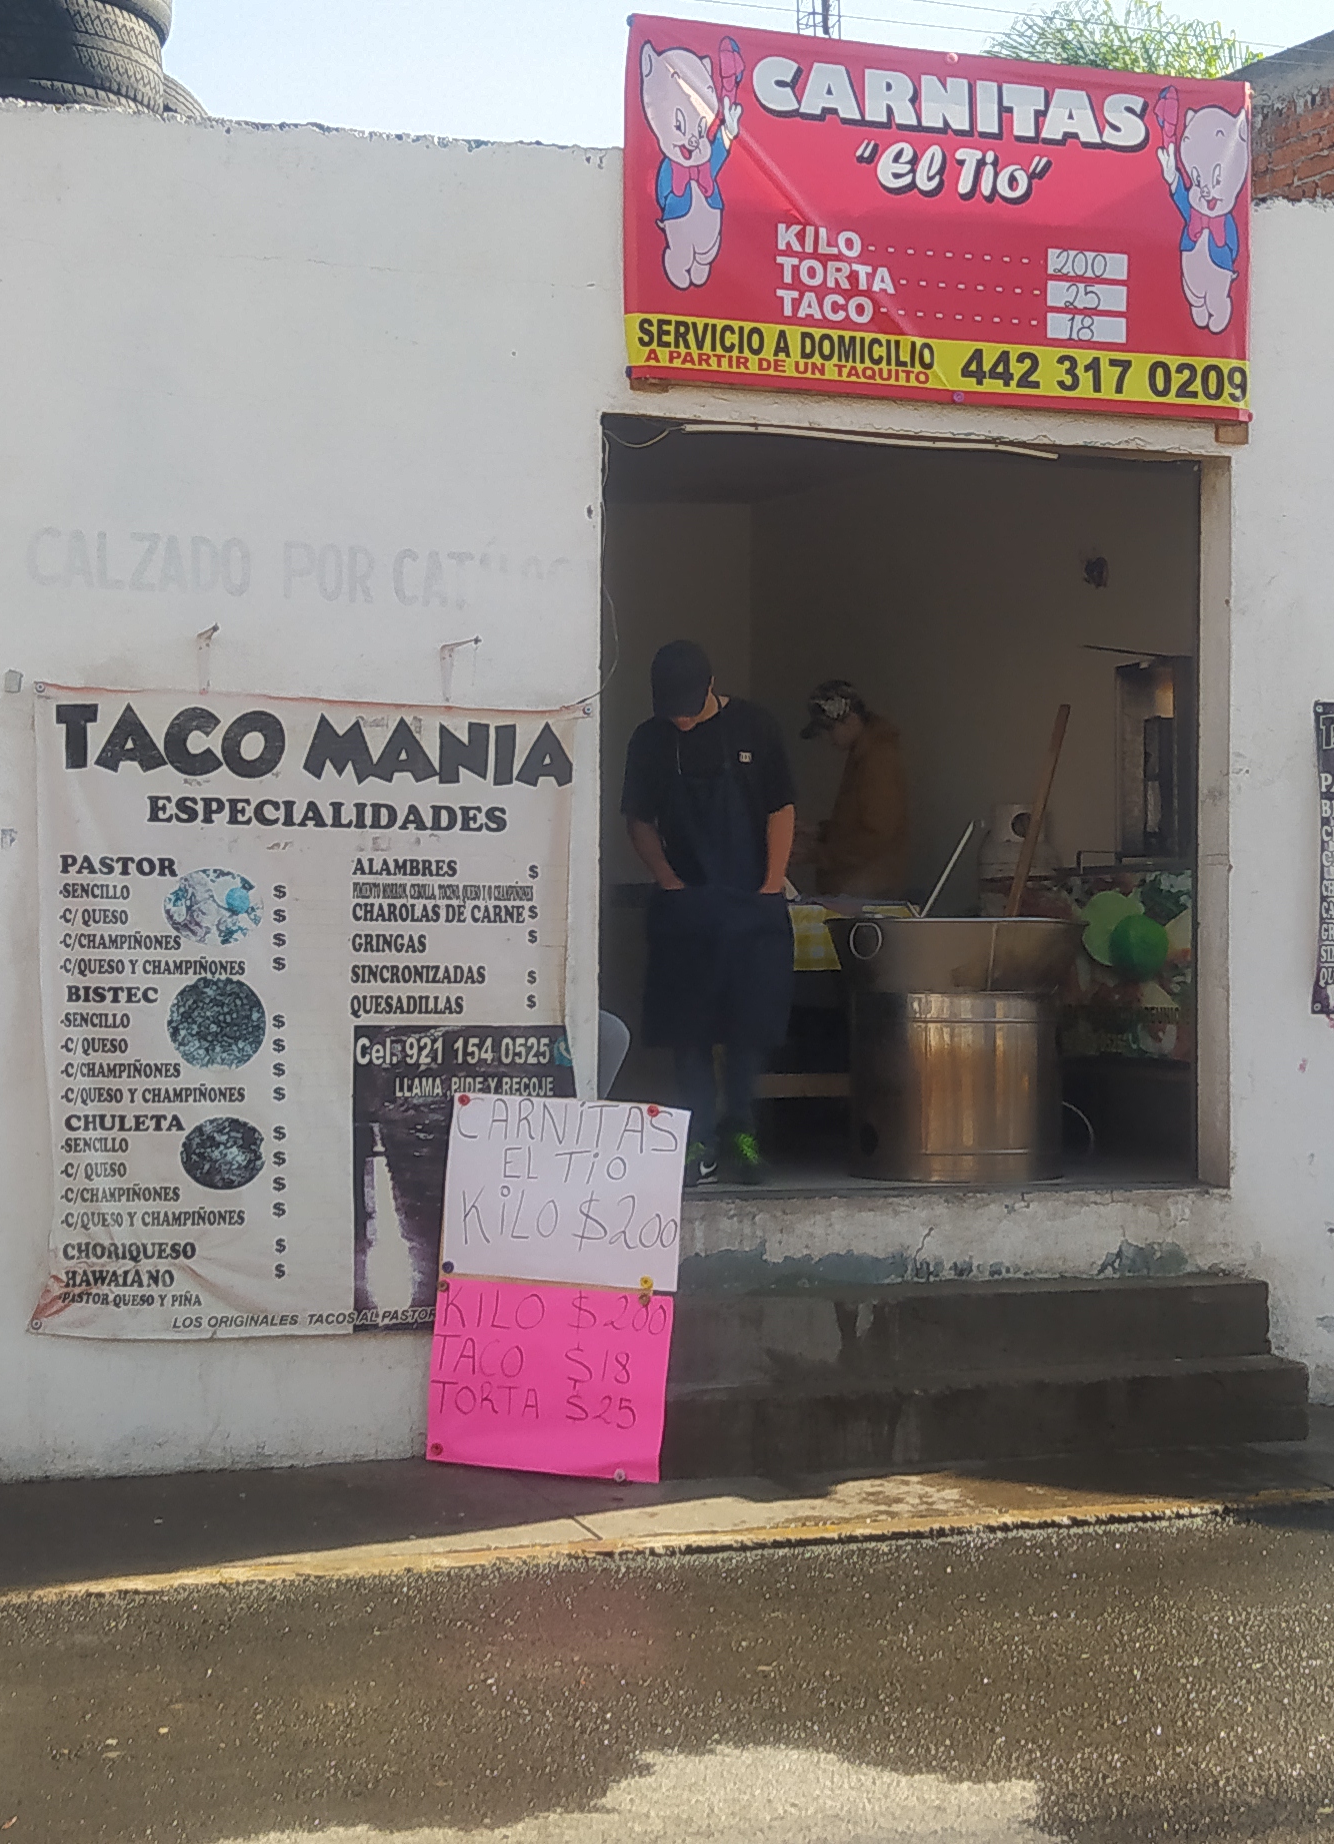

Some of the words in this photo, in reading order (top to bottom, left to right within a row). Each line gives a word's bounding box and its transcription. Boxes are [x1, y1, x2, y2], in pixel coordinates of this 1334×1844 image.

[752, 56, 1150, 150] CARNITAS
[777, 223, 861, 258] KILO
[1053, 250, 1107, 278] 200
[777, 256, 895, 294] TORTA
[1064, 284, 1101, 310] 25
[777, 288, 872, 323] TACO
[1067, 314, 1094, 341] 18
[637, 318, 764, 356] SERVICIO
[773, 329, 792, 358] A
[800, 331, 935, 370] DOMICILIO
[644, 349, 661, 363] A
[668, 351, 750, 370] PARTIR
[758, 359, 786, 373] DE
[794, 360, 826, 376] UN
[833, 364, 929, 384] TAQUITO
[960, 348, 1041, 389] 442
[1056, 355, 1133, 394] 317
[1148, 361, 1247, 402] 0209
[25, 526, 252, 597] CALZADO
[283, 540, 373, 604] POR
[56, 702, 286, 778] TACO
[303, 713, 573, 787] MANIA
[147, 796, 507, 833] ESPECIALIDADES
[60, 854, 178, 877] PASTOR
[352, 857, 458, 878] ALAMBRES
[528, 864, 539, 879] $
[273, 884, 287, 899] $
[81, 908, 129, 927] QUESO
[273, 908, 287, 923] $
[352, 903, 440, 922] CHAROLAS
[445, 905, 466, 923] DE
[471, 905, 525, 923] CARNE
[528, 905, 539, 920] $
[273, 933, 287, 948] $
[352, 933, 427, 953] GRINGAS
[528, 930, 538, 944] $
[128, 959, 139, 975] Y
[142, 956, 246, 978] CHAMPIÑONES
[273, 956, 287, 971] $
[351, 965, 486, 986] SINCRONIZADAS
[527, 969, 537, 985] $
[66, 985, 159, 1003] BISTEC
[350, 995, 464, 1018] QUESADILLAS
[526, 994, 537, 1010] $
[272, 1014, 286, 1029] $
[81, 1037, 129, 1055] QUESO
[272, 1037, 286, 1053] $
[405, 1037, 443, 1064] 921
[453, 1037, 493, 1064] 154
[500, 1037, 550, 1065] 0525
[272, 1062, 286, 1077] $
[127, 1088, 138, 1104] Y
[141, 1083, 246, 1103] CHAMPIÑONES
[272, 1086, 286, 1102] $
[395, 1077, 442, 1097] LLAMA
[488, 1077, 497, 1096] Y
[502, 1077, 554, 1096] RECOJE
[64, 1114, 186, 1132] CHULETA
[273, 1126, 287, 1141] $
[84, 1162, 127, 1180] QUESO
[273, 1151, 287, 1167] $
[503, 1146, 538, 1180] EL
[273, 1176, 287, 1192] $
[127, 1211, 138, 1227] Y
[141, 1207, 245, 1227] CHAMPIÑONES
[273, 1202, 287, 1217] $
[62, 1241, 197, 1263] CHORIQUESO
[274, 1238, 286, 1254] $
[64, 1269, 175, 1288] HAWAIANO
[274, 1263, 286, 1279] $
[112, 1294, 154, 1309] QUESO
[157, 1294, 167, 1307] Y
[171, 1291, 202, 1307] PIÑA
[442, 1286, 544, 1331] KILO
[172, 1316, 202, 1329] LOS
[207, 1314, 298, 1328] ORIGINALES
[307, 1312, 355, 1326] TACOS
[357, 1310, 378, 1324] AL
[434, 1334, 525, 1378] TACO
[430, 1379, 540, 1420] TORTA
